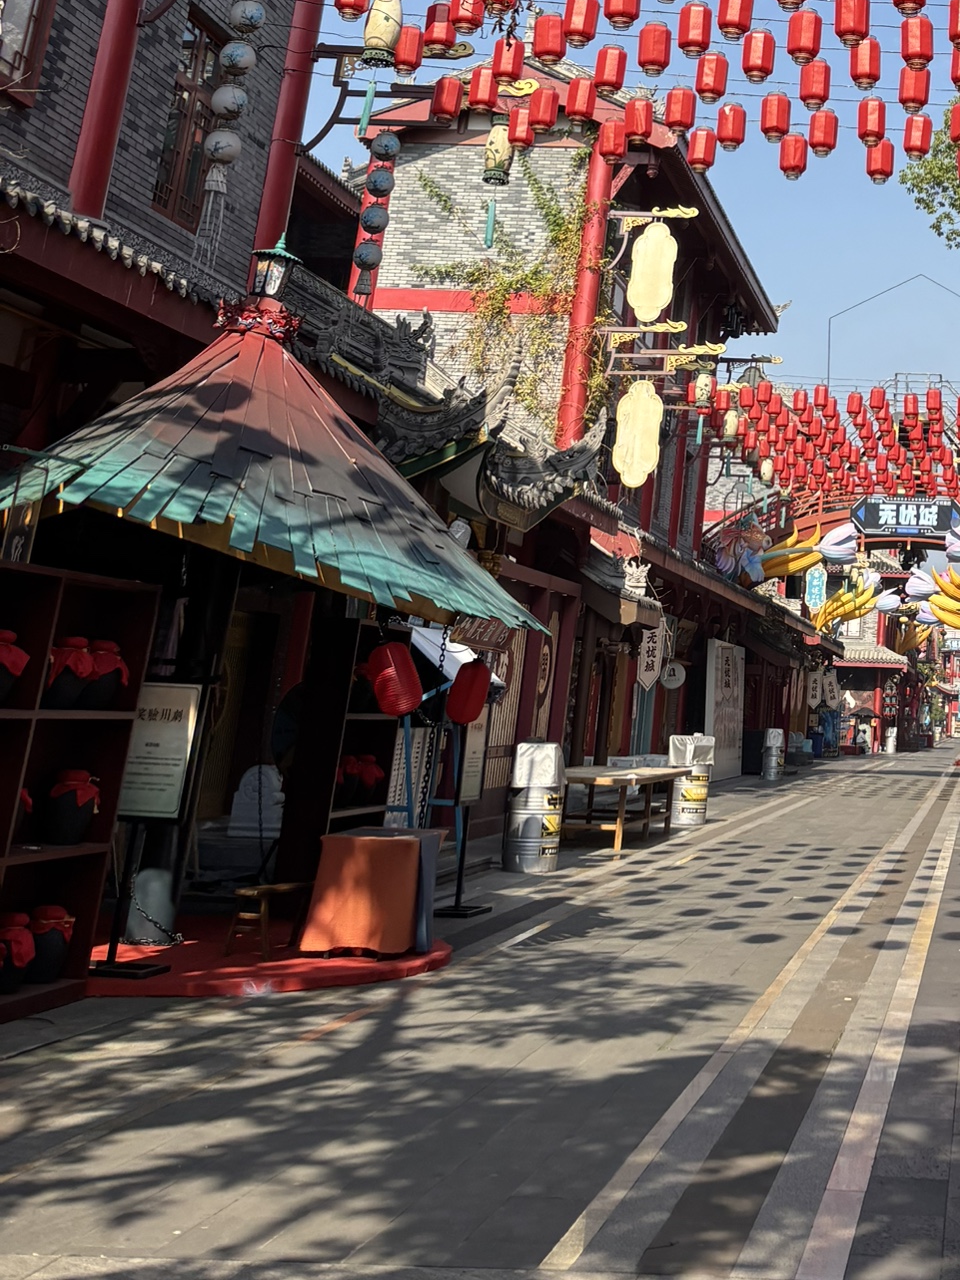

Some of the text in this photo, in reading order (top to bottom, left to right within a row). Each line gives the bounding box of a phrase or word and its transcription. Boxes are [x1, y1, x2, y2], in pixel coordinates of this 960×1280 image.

[878, 504, 939, 527] 无忧城
[644, 631, 657, 673] 无忧城
